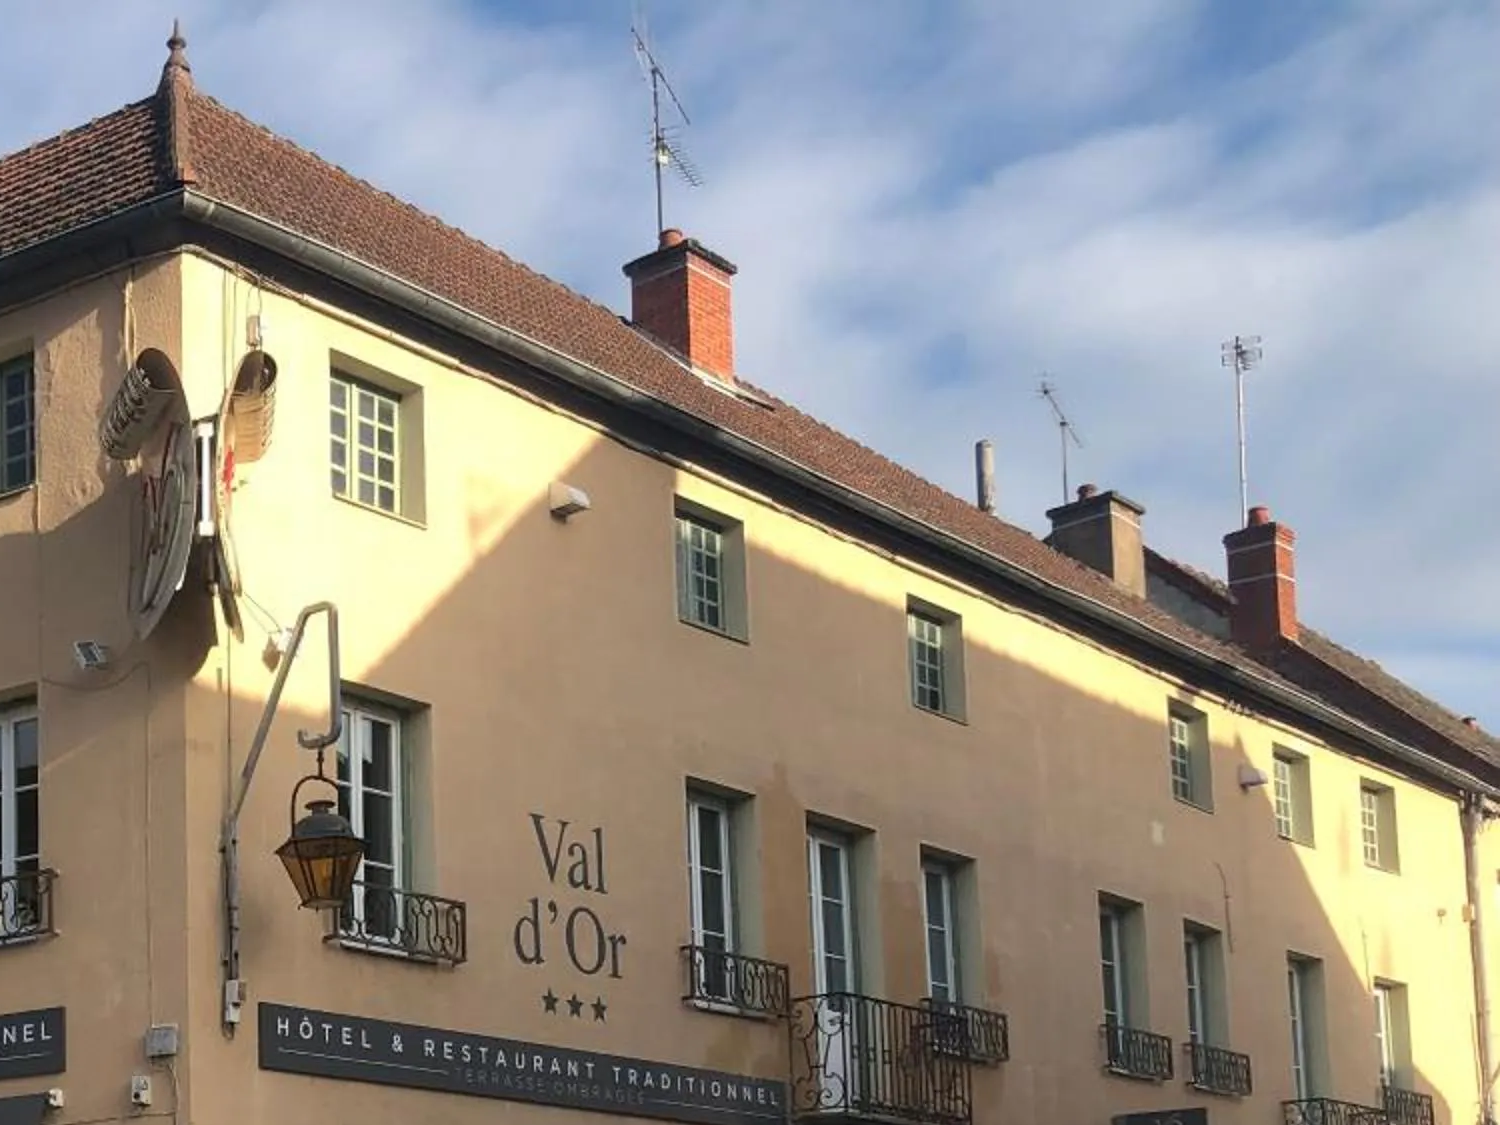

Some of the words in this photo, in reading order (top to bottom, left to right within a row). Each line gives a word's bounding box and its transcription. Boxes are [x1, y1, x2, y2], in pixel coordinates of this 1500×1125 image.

[529, 813, 608, 894] Val
[514, 898, 627, 978] d'Or
[277, 1016, 372, 1049] HÔTEL
[392, 1035, 403, 1053] &
[424, 1039, 595, 1080] RESTAURANT
[612, 1066, 780, 1106] TRADITIONNEL
